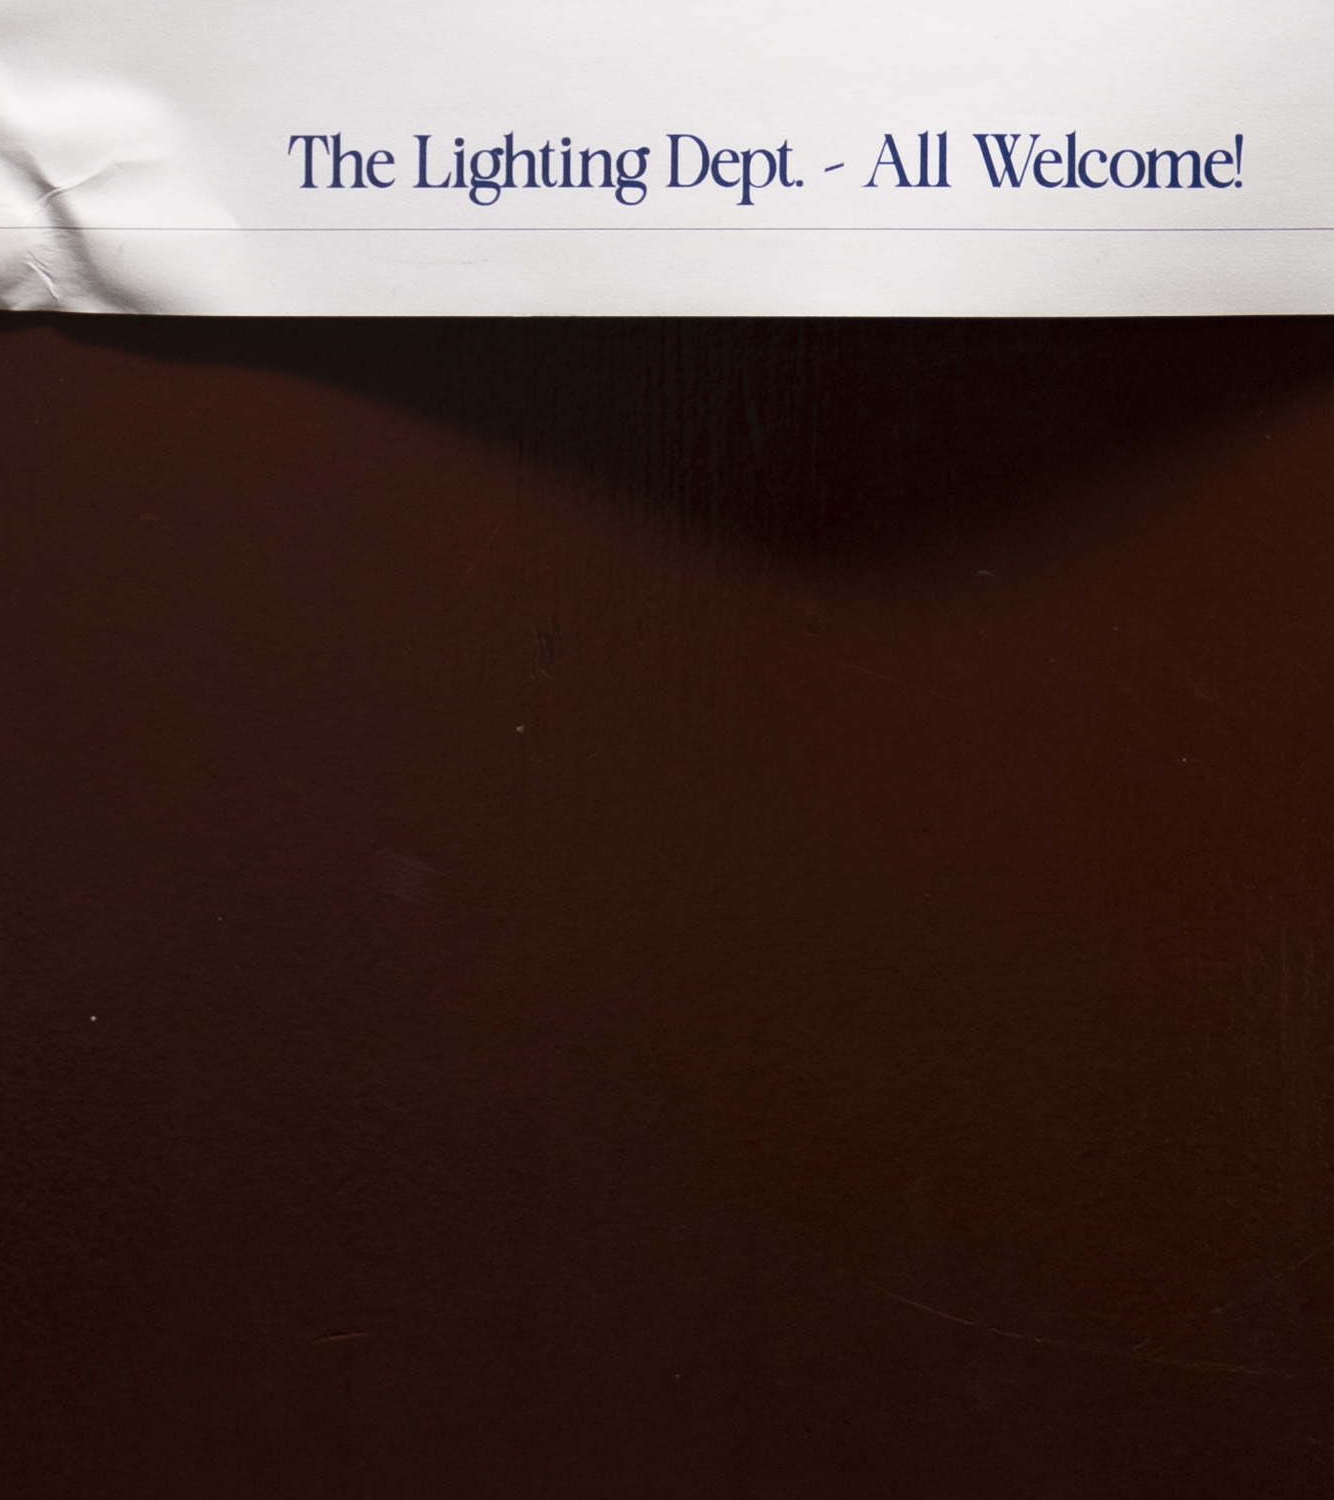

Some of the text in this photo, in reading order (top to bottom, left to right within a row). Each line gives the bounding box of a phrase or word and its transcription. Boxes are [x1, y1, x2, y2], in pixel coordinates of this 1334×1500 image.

[288, 132, 396, 189] The
[412, 131, 651, 206] Lighting
[666, 134, 804, 206] Dept.
[861, 130, 952, 188] All
[972, 130, 1244, 189] Welcome!
